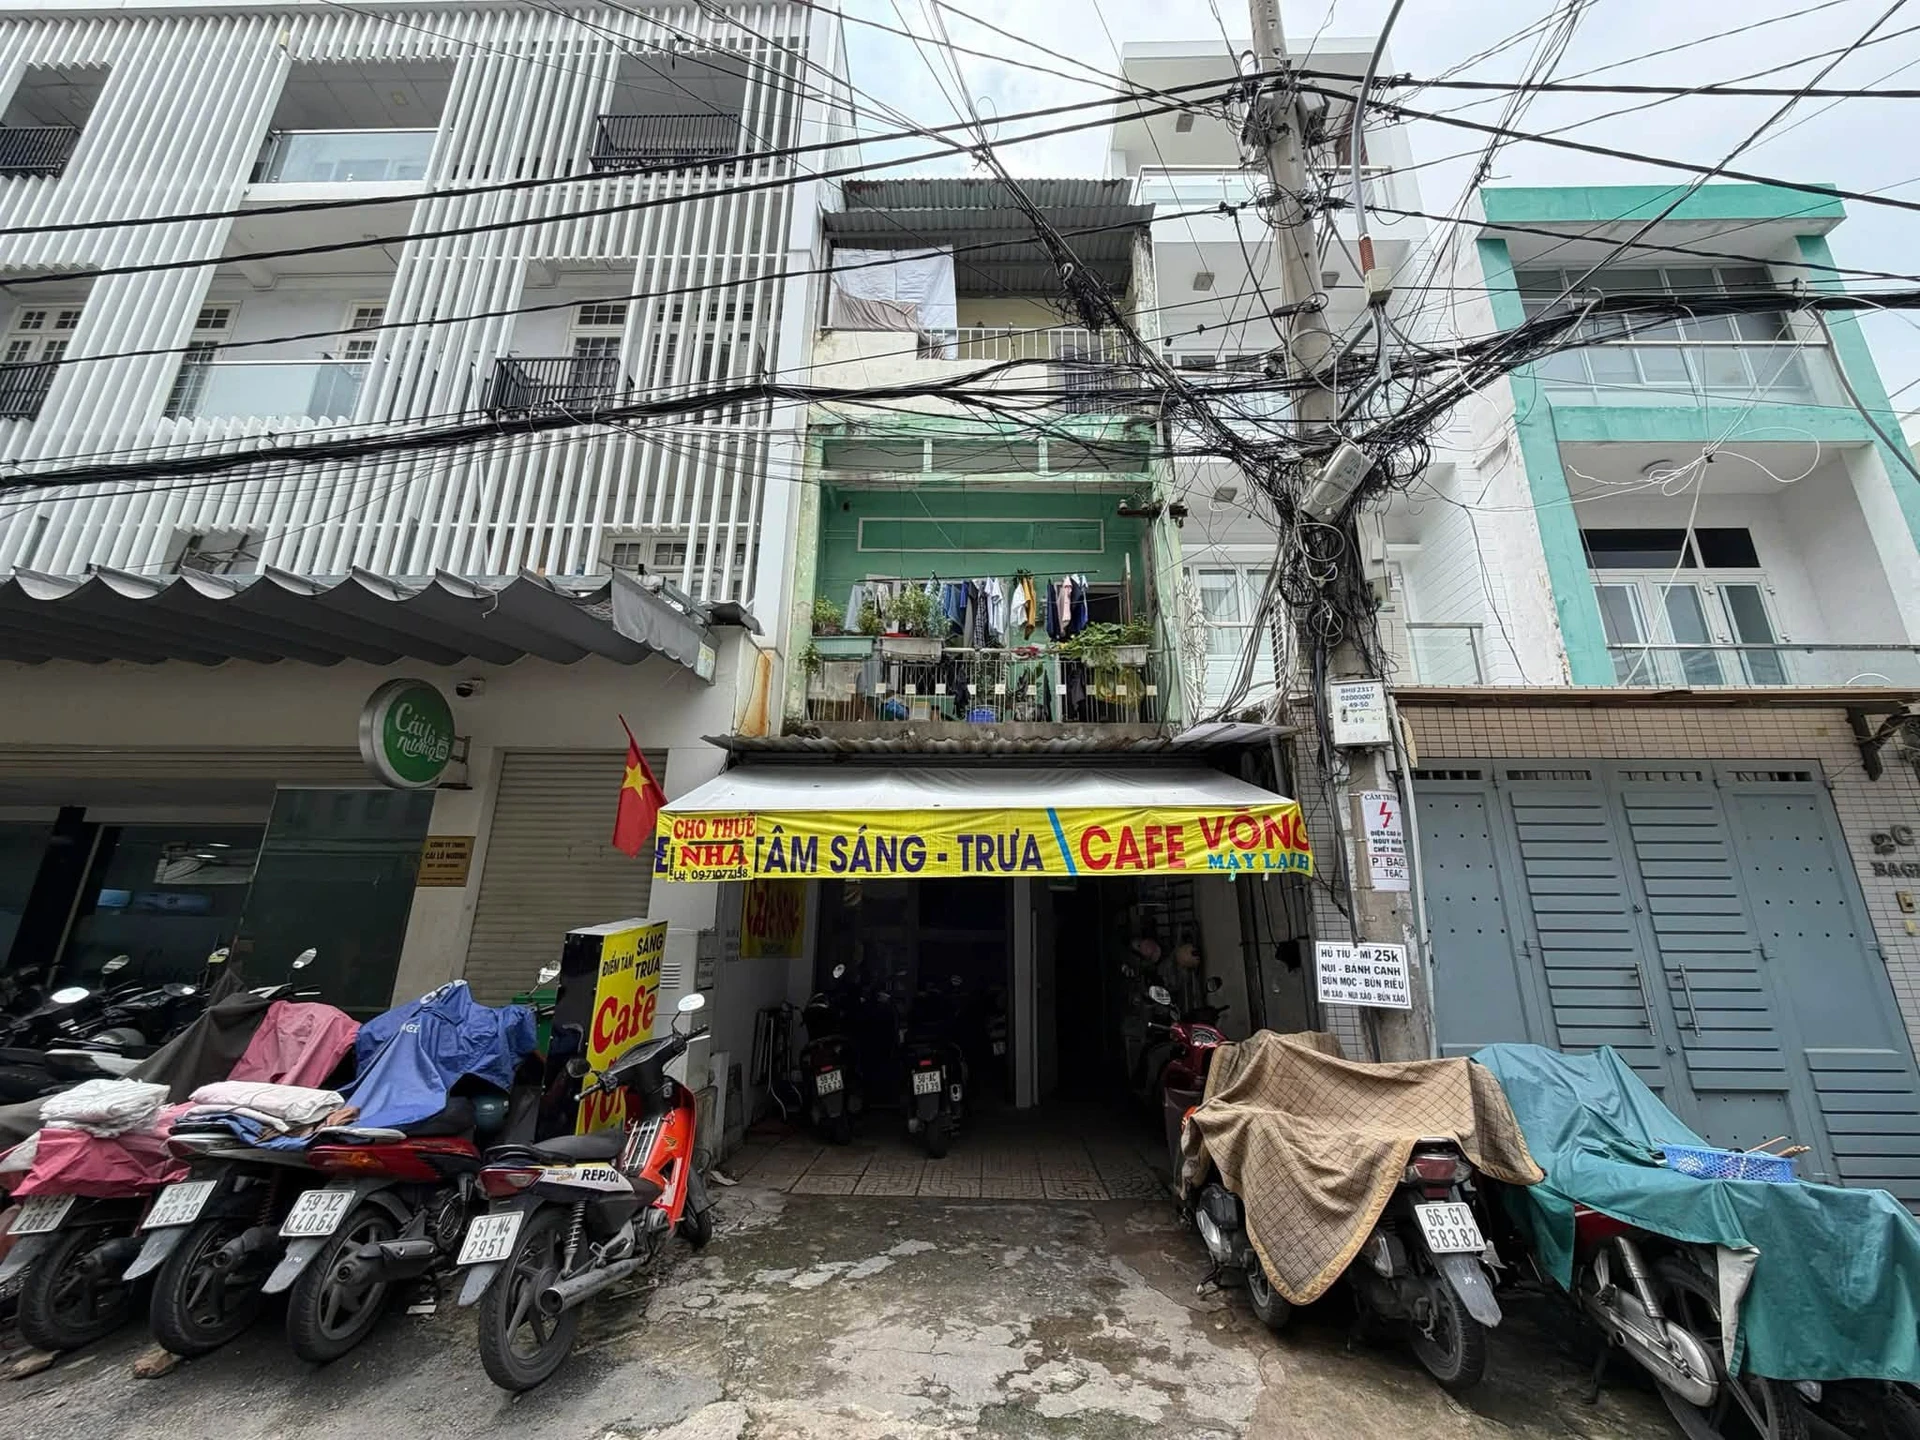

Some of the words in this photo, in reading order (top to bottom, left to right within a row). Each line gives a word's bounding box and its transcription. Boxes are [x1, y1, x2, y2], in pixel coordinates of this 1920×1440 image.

[396, 703, 424, 736] Cái
[673, 818, 707, 840] CHO
[829, 824, 927, 873] SÁNG
[957, 827, 1044, 873] TRƯA
[1080, 825, 1187, 871] CAFE
[1207, 849, 1257, 869] MÁY
[636, 931, 663, 957] SÁNG
[1374, 949, 1399, 962] 25k
[1321, 964, 1336, 972] NUI
[1374, 966, 1401, 976] CANH
[302, 1194, 345, 1212] 59-X2
[475, 1216, 512, 1238] 51-N4
[1428, 1228, 1481, 1248] 583.82
[465, 1236, 506, 1259] 2951
